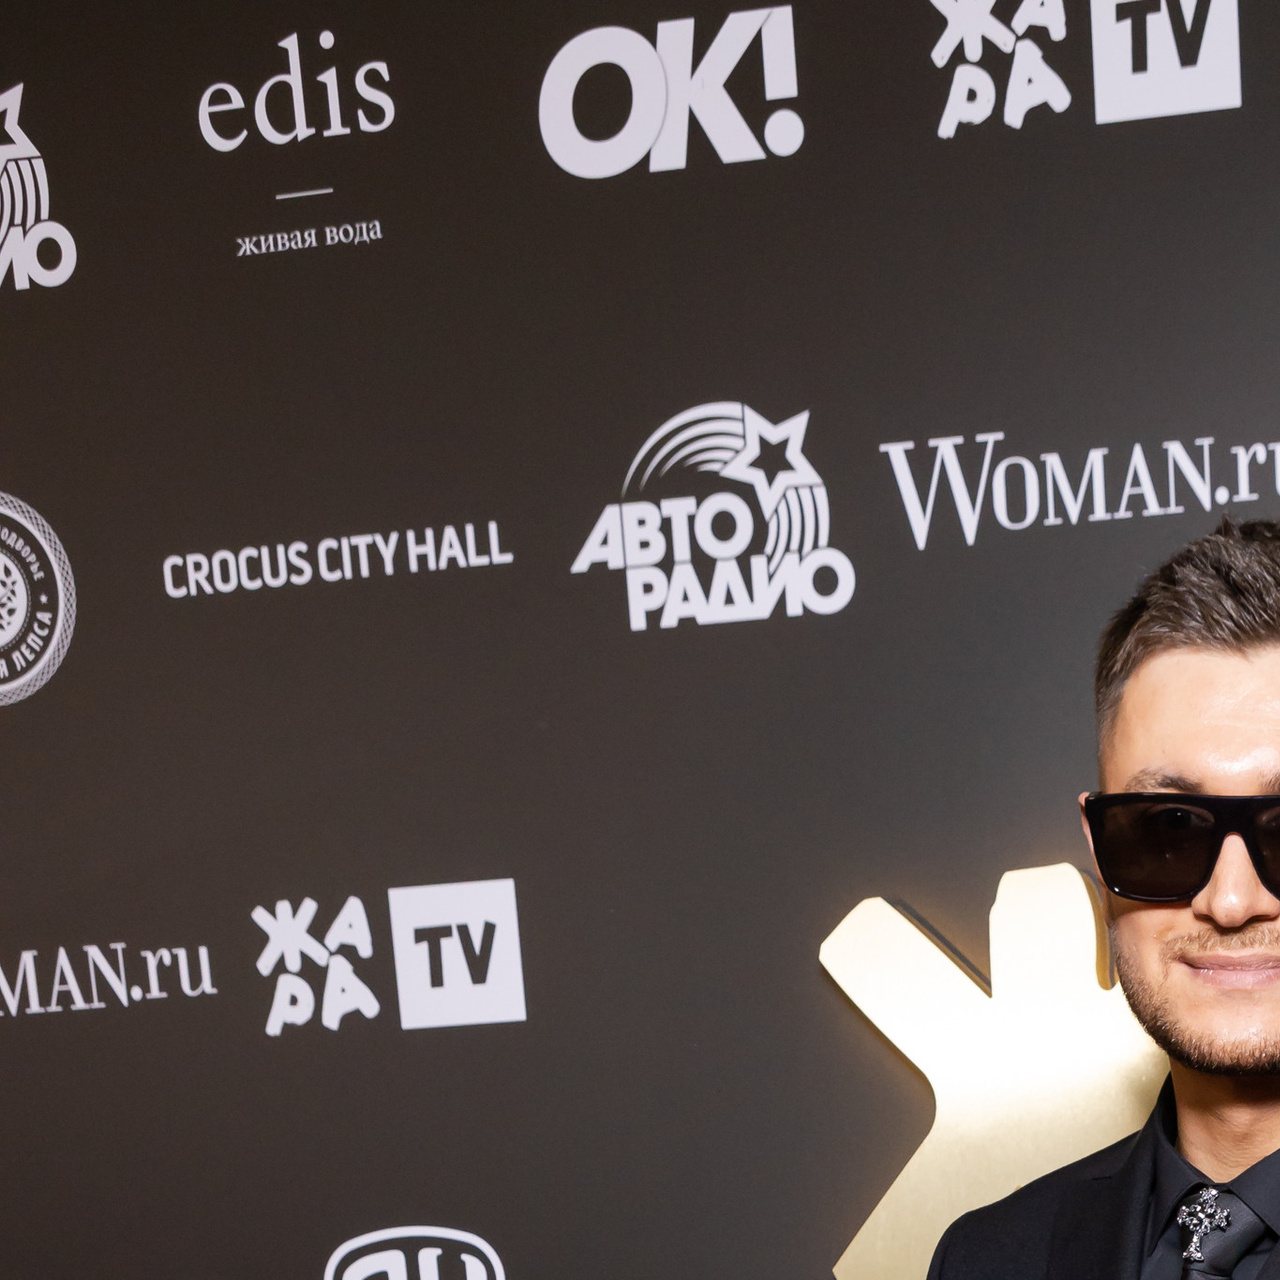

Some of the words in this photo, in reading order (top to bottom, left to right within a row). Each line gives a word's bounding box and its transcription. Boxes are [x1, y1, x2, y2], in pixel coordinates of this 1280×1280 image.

[1115, 0, 1212, 75] TV
[199, 31, 394, 151] edis
[539, 5, 804, 178] OK!
[236, 230, 317, 257] живая
[325, 221, 383, 246] вода
[162, 541, 313, 598] CROCUS
[317, 532, 399, 582] CITY
[406, 521, 514, 573] HALL
[570, 491, 754, 574] АВТО
[625, 546, 857, 632] РАДИО
[11, 611, 53, 672] ЛЕПСА
[413, 919, 497, 989] TV
